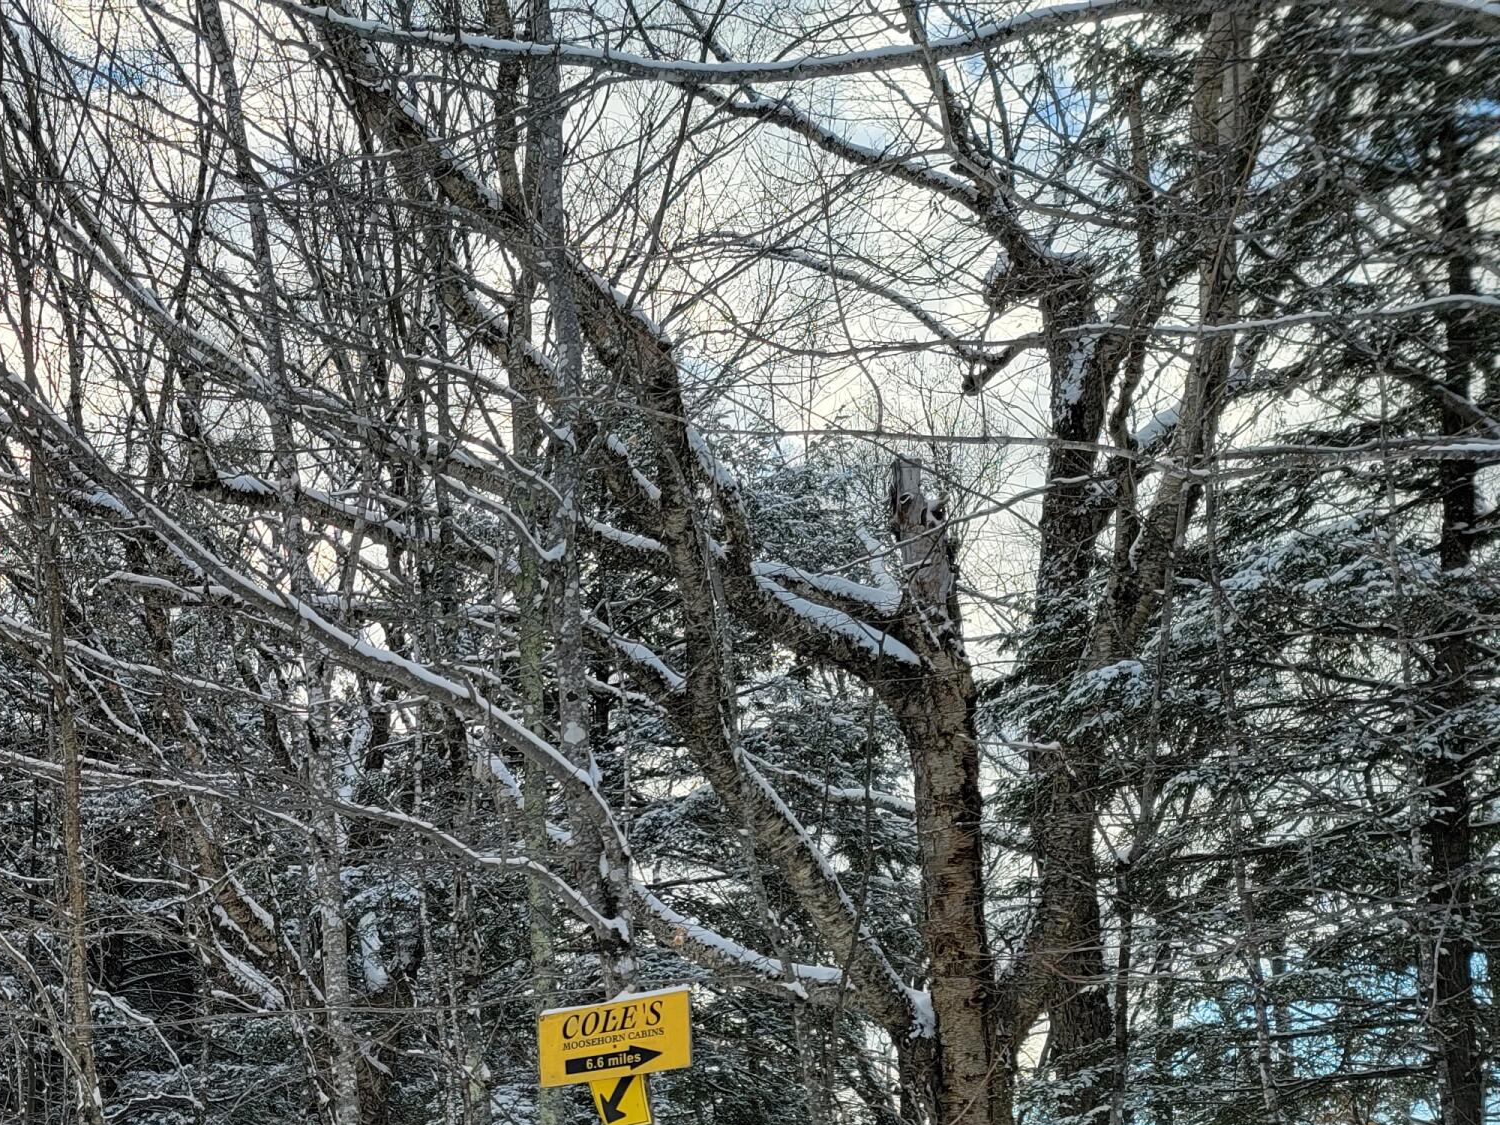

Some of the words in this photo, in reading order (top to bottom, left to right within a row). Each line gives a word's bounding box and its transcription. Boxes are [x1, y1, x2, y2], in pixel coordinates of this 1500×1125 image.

[562, 1000, 664, 1040] COLE'S
[562, 1033, 626, 1051] MOOSEHORN
[628, 1028, 664, 1040] CABINS
[586, 1058, 604, 1071] 6.6
[607, 1052, 642, 1067] miles
